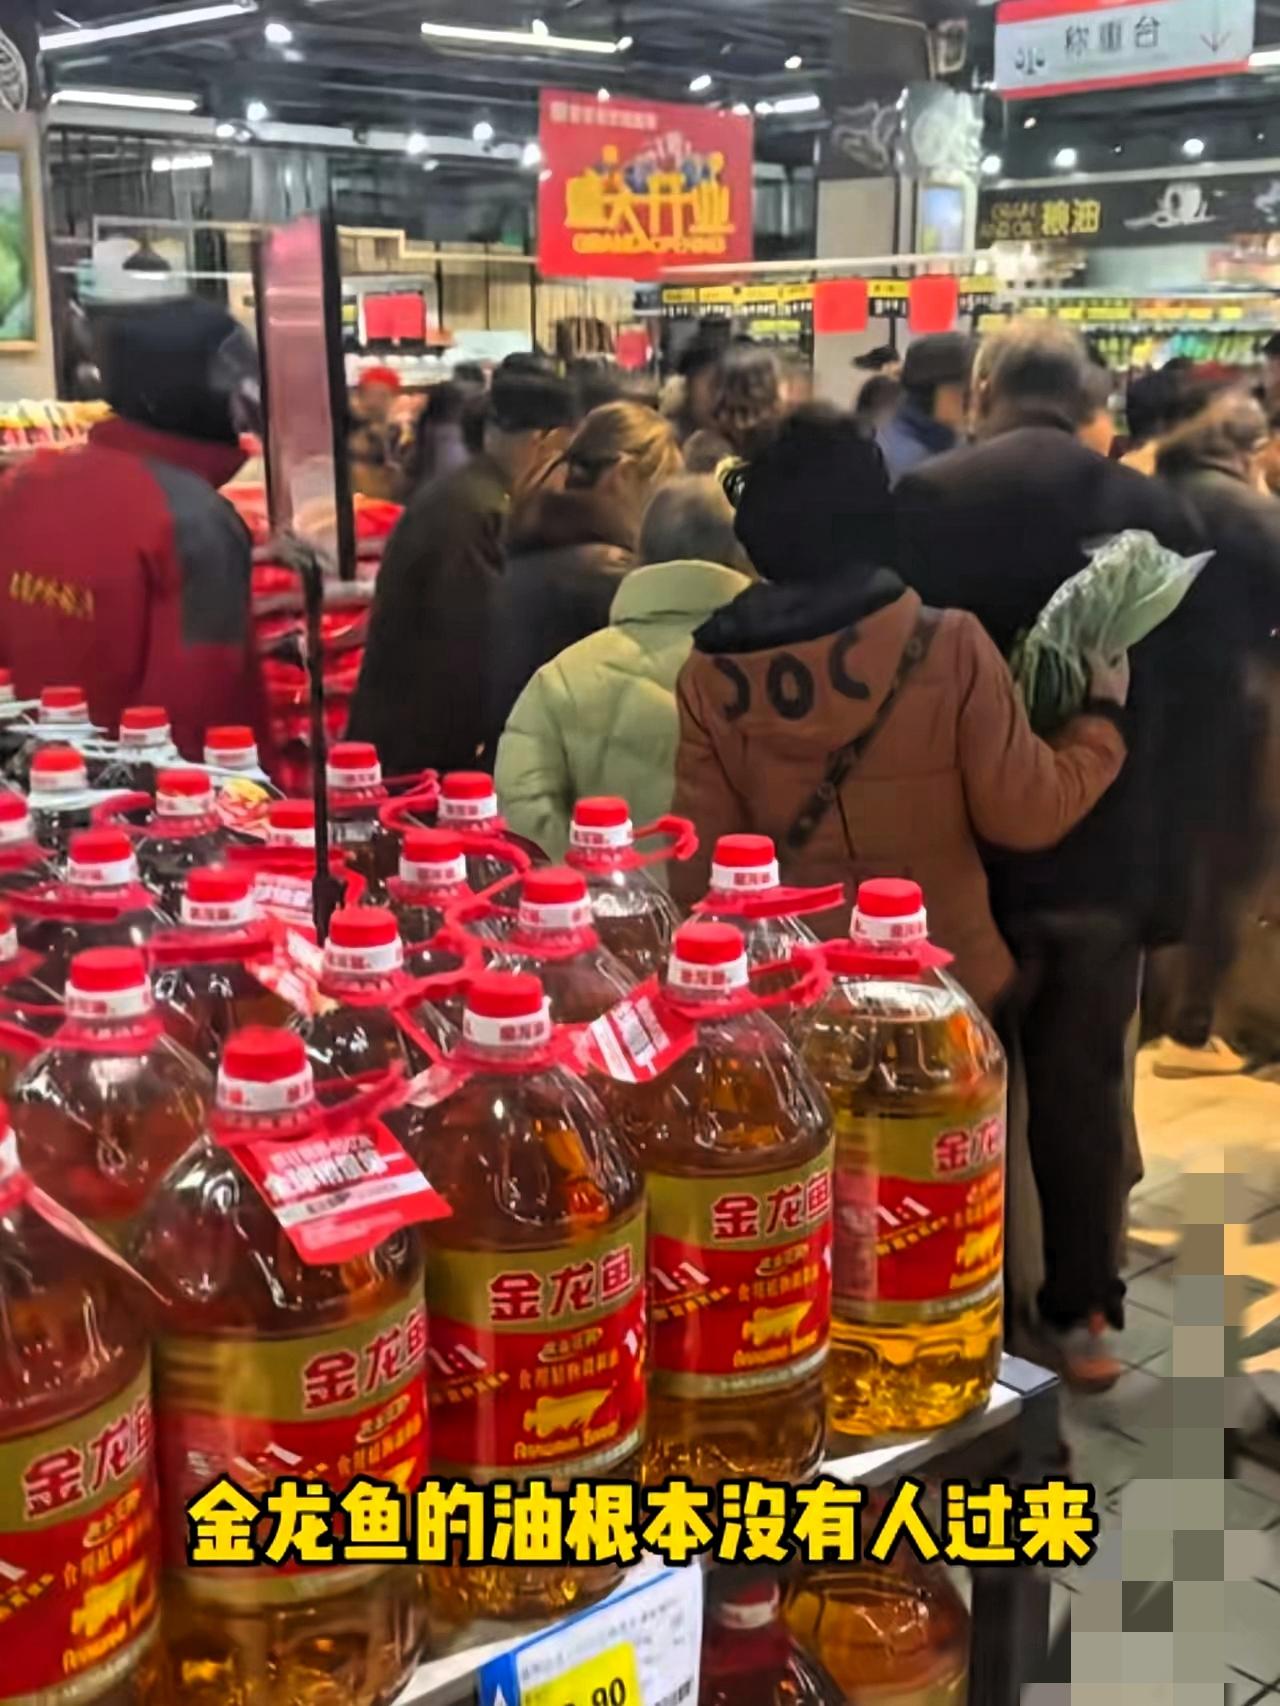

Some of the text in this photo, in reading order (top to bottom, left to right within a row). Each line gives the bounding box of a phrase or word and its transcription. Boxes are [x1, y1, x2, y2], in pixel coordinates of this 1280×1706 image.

[711, 1168, 831, 1243] 金龙鱼
[487, 1244, 634, 1324] 金龙鱼
